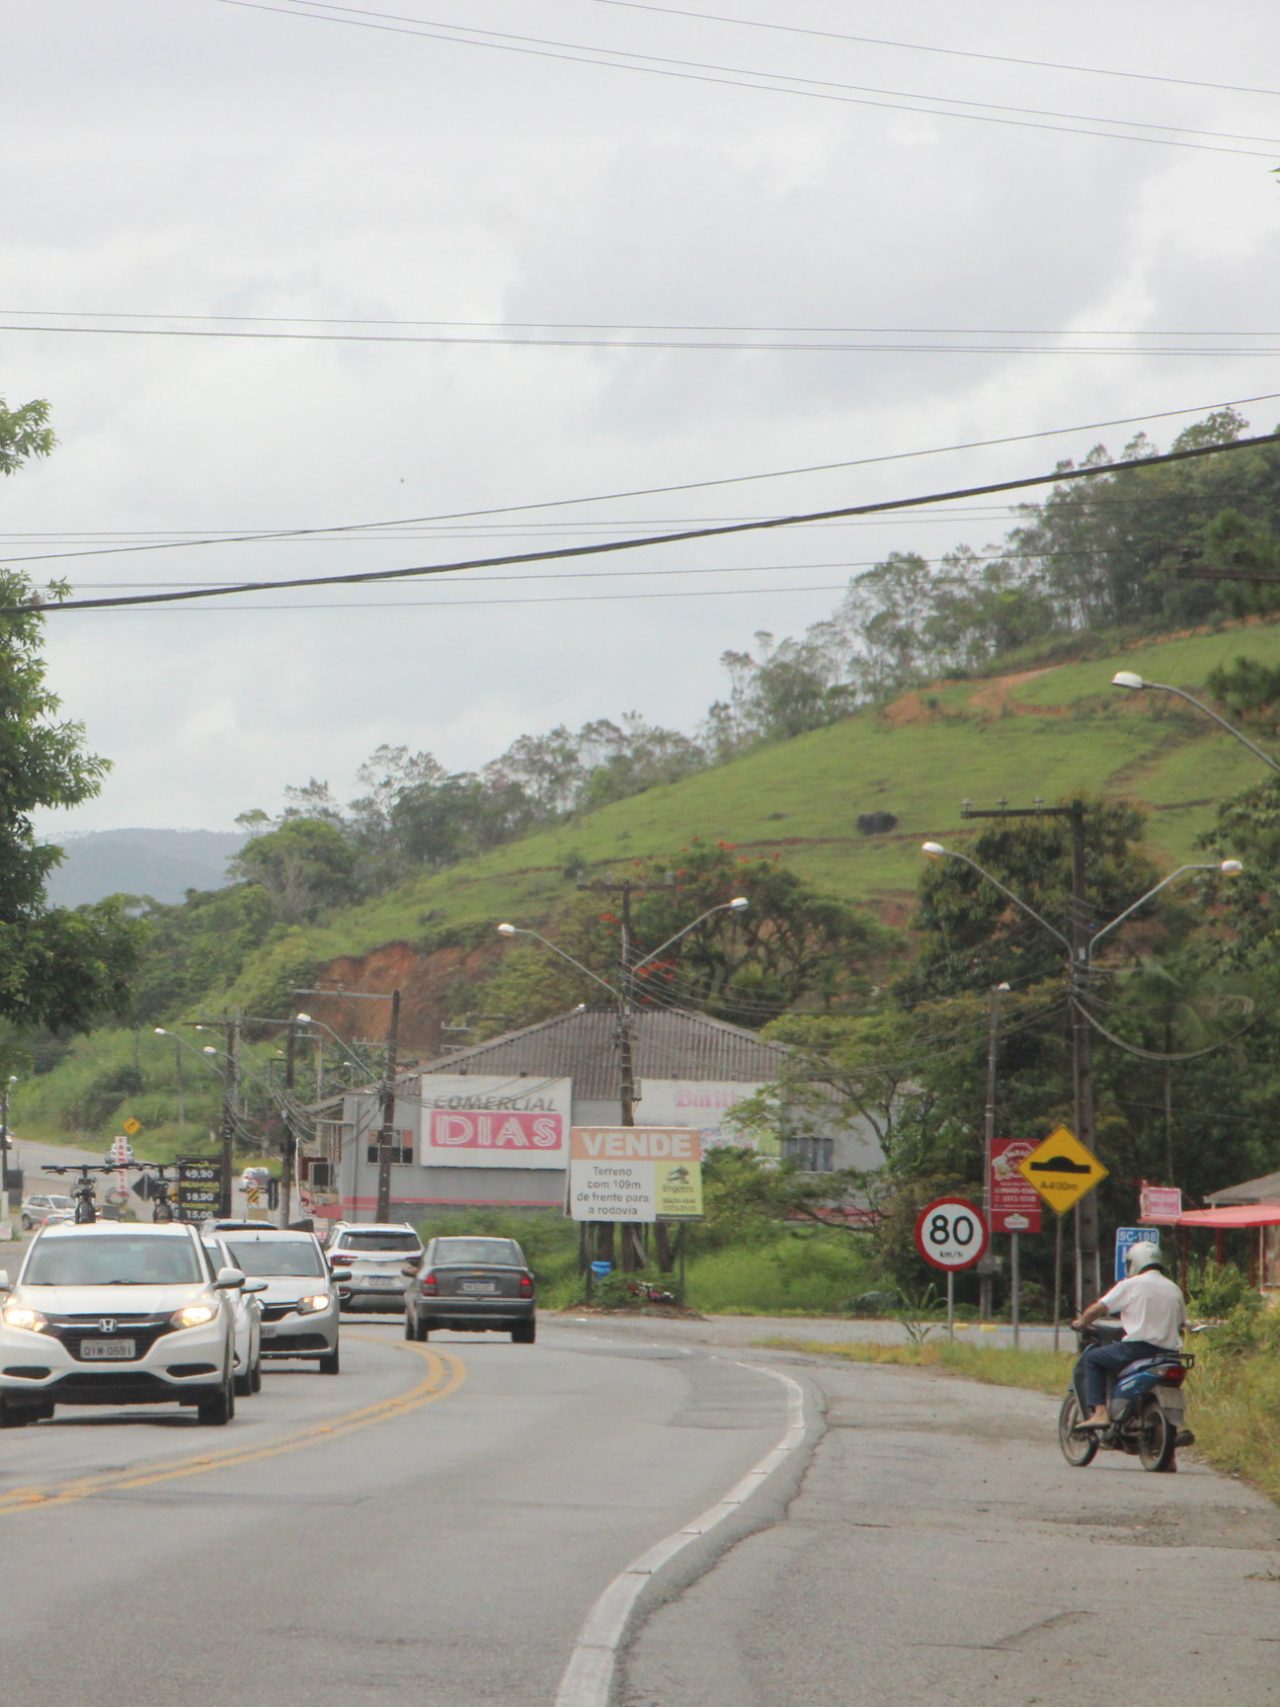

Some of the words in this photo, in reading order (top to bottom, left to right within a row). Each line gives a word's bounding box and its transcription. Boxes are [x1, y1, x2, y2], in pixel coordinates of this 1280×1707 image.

[434, 1095, 557, 1111] COMERCIAL
[436, 1115, 557, 1147] DIAS
[581, 1132, 692, 1157] VENDE
[593, 1166, 632, 1176] Terreno
[587, 1181, 609, 1189] com
[614, 1180, 641, 1189] 109m
[577, 1192, 589, 1201] de
[592, 1193, 623, 1202] frente
[626, 1194, 649, 1204] para
[598, 1206, 638, 1215] rodovia
[930, 1214, 974, 1246] 80
[1120, 1231, 1157, 1242] SC-108
[939, 1250, 964, 1258] km/h
